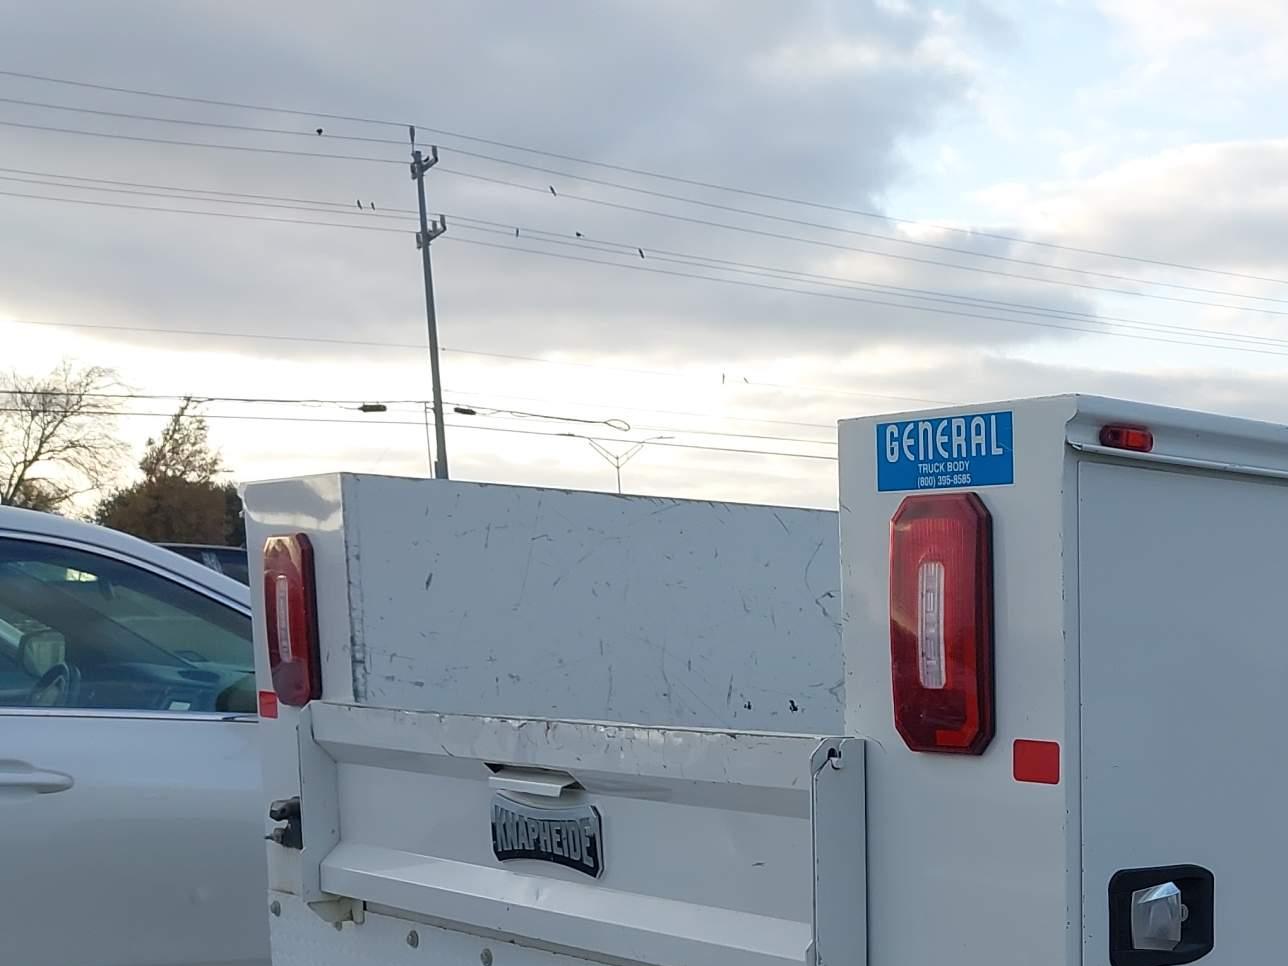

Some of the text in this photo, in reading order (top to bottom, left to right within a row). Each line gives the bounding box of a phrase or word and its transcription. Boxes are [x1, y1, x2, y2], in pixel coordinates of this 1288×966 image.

[886, 415, 1003, 463] GENERAL
[917, 476, 936, 489] (800)
[918, 461, 970, 474] TRUCK BODY
[494, 804, 596, 868] KNAPHEIDE
